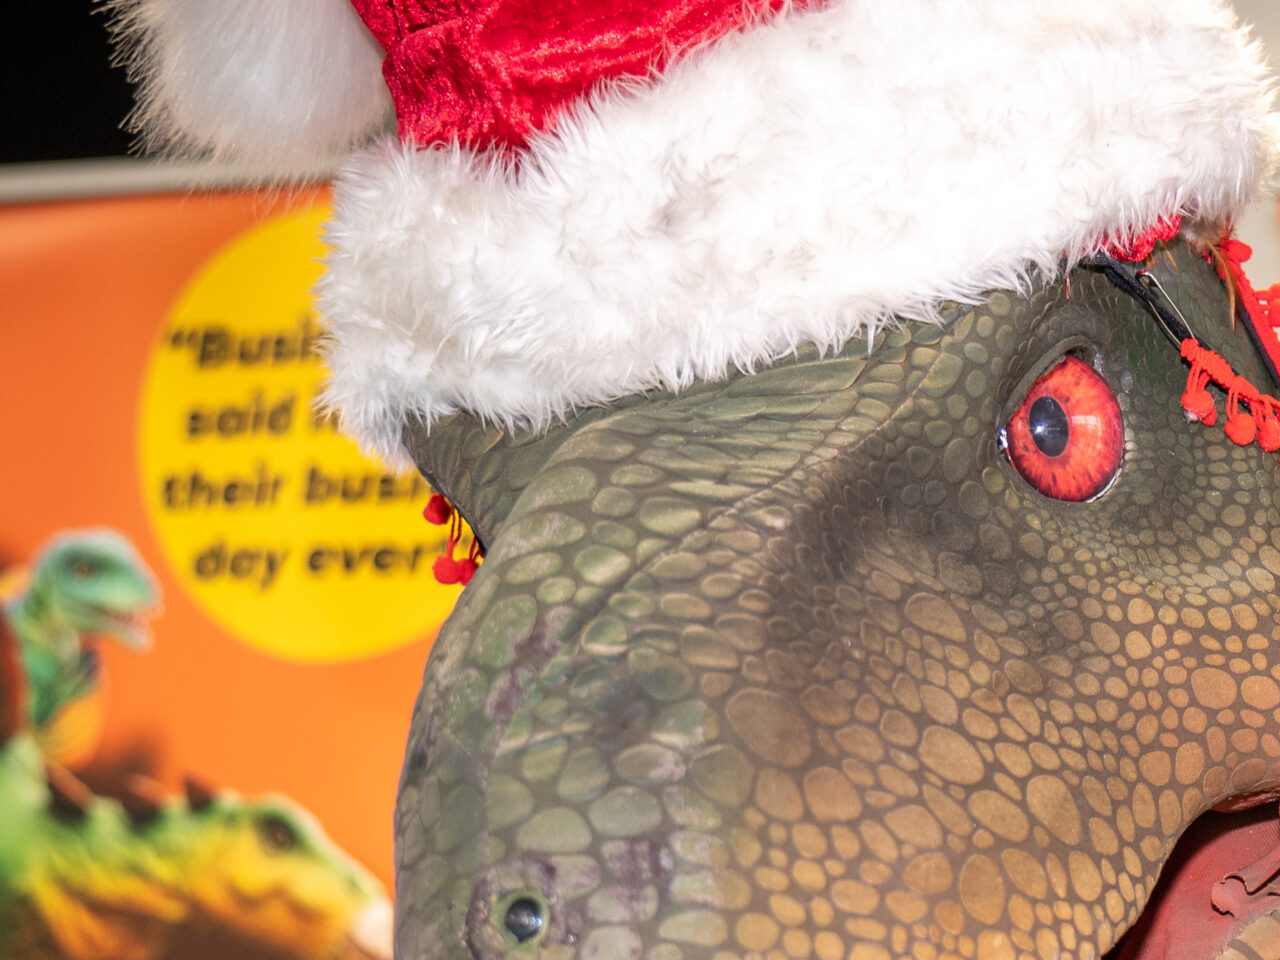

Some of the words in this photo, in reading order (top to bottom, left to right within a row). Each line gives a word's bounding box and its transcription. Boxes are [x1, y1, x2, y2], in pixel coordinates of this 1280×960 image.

[170, 315, 328, 368] “Busi
[187, 389, 296, 437] said
[164, 461, 283, 511] their
[304, 464, 438, 505] busi
[195, 534, 288, 589] day
